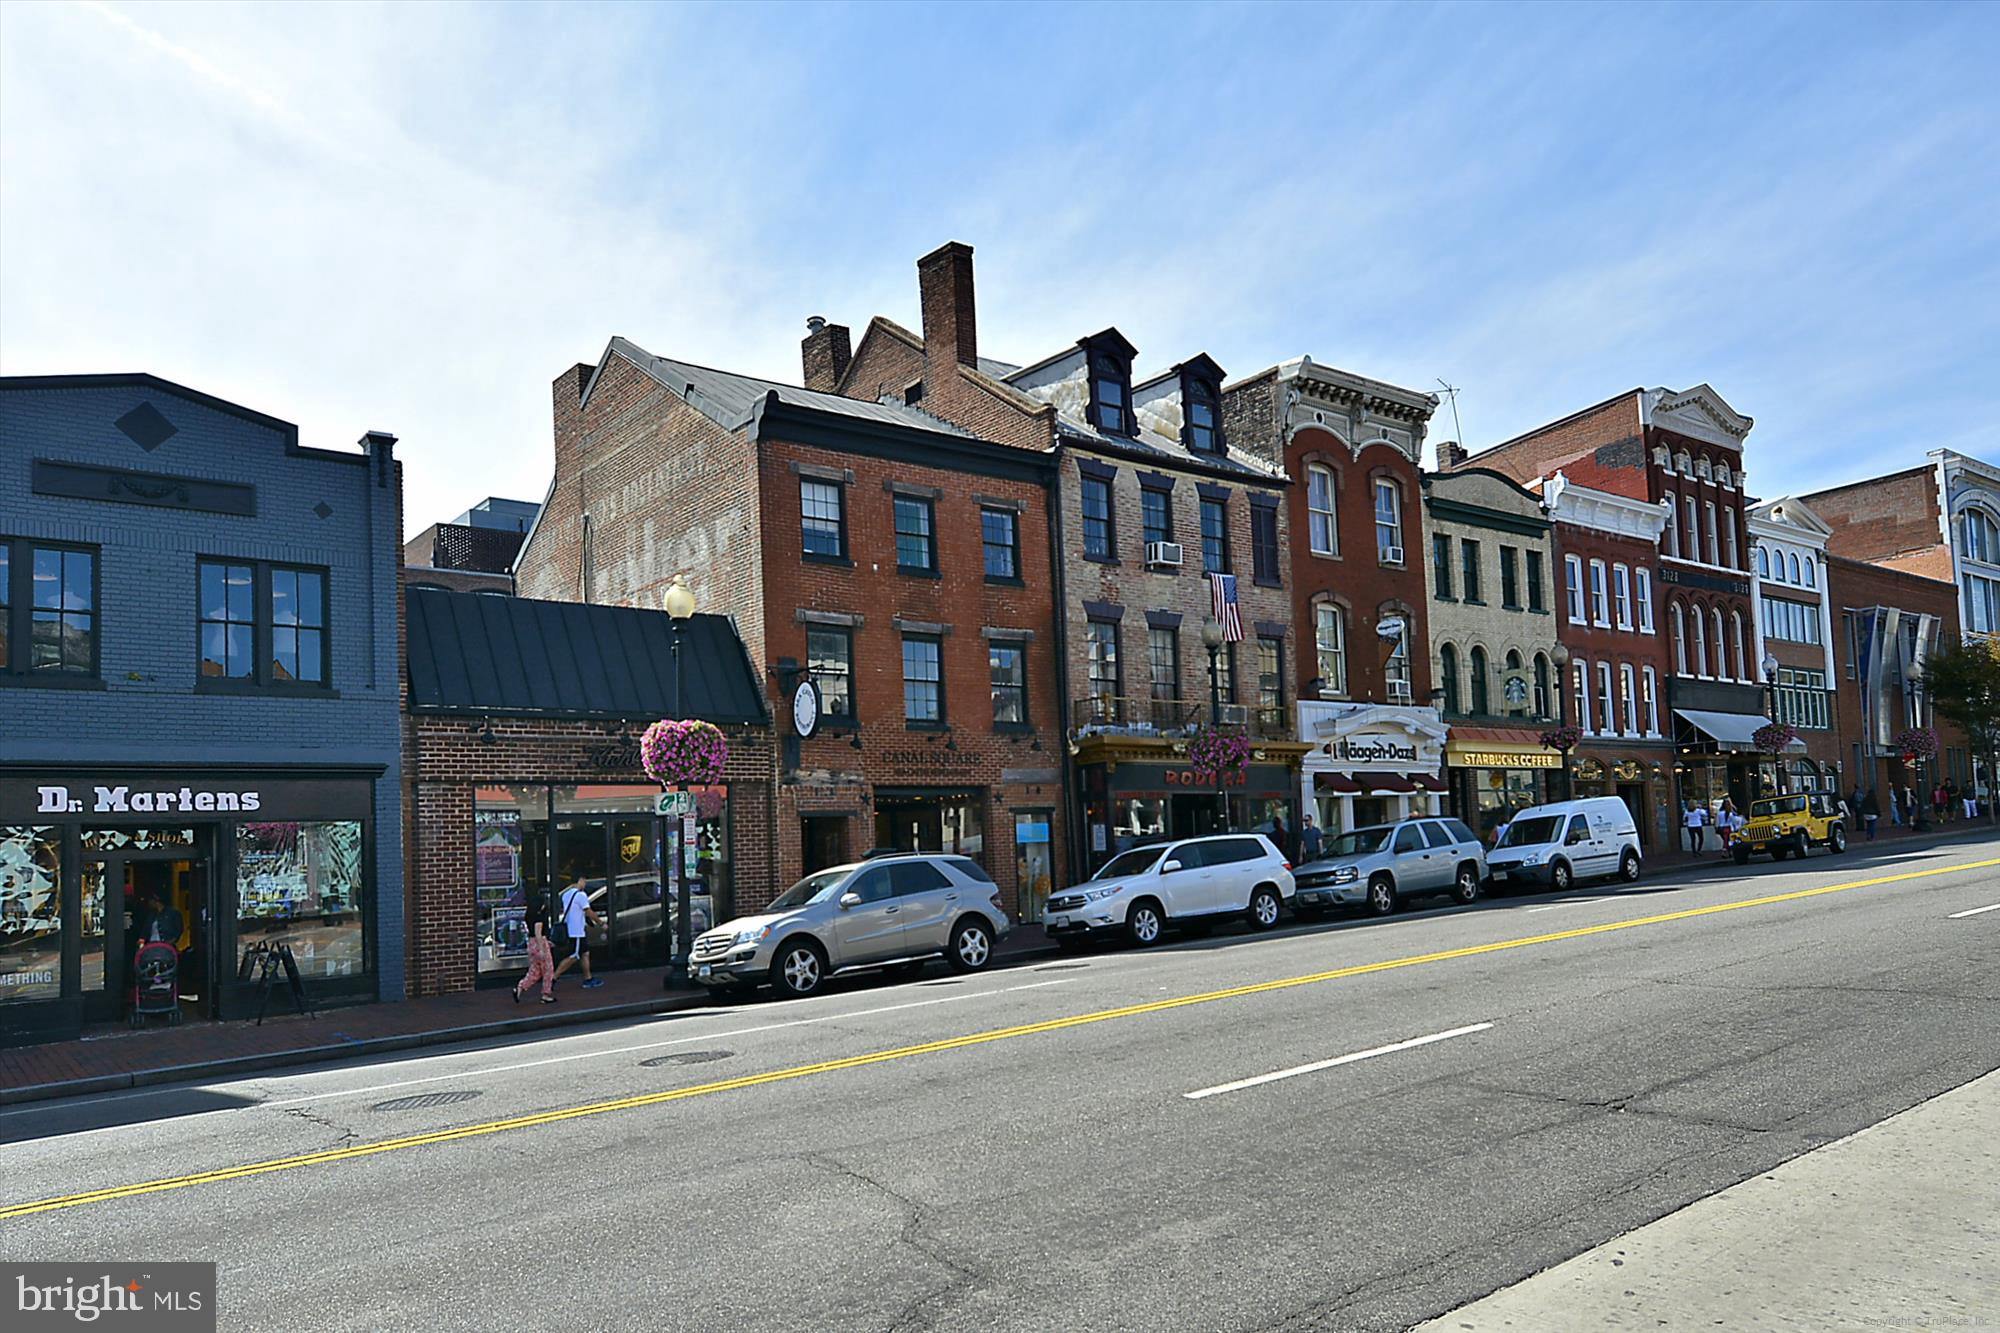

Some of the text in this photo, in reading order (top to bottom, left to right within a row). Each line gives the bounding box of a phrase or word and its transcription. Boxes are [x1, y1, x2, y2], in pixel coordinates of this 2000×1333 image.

[881, 751, 927, 764] CANAL
[1464, 753, 1519, 766] STARBUCKS
[37, 786, 261, 812] Dr. Martens
